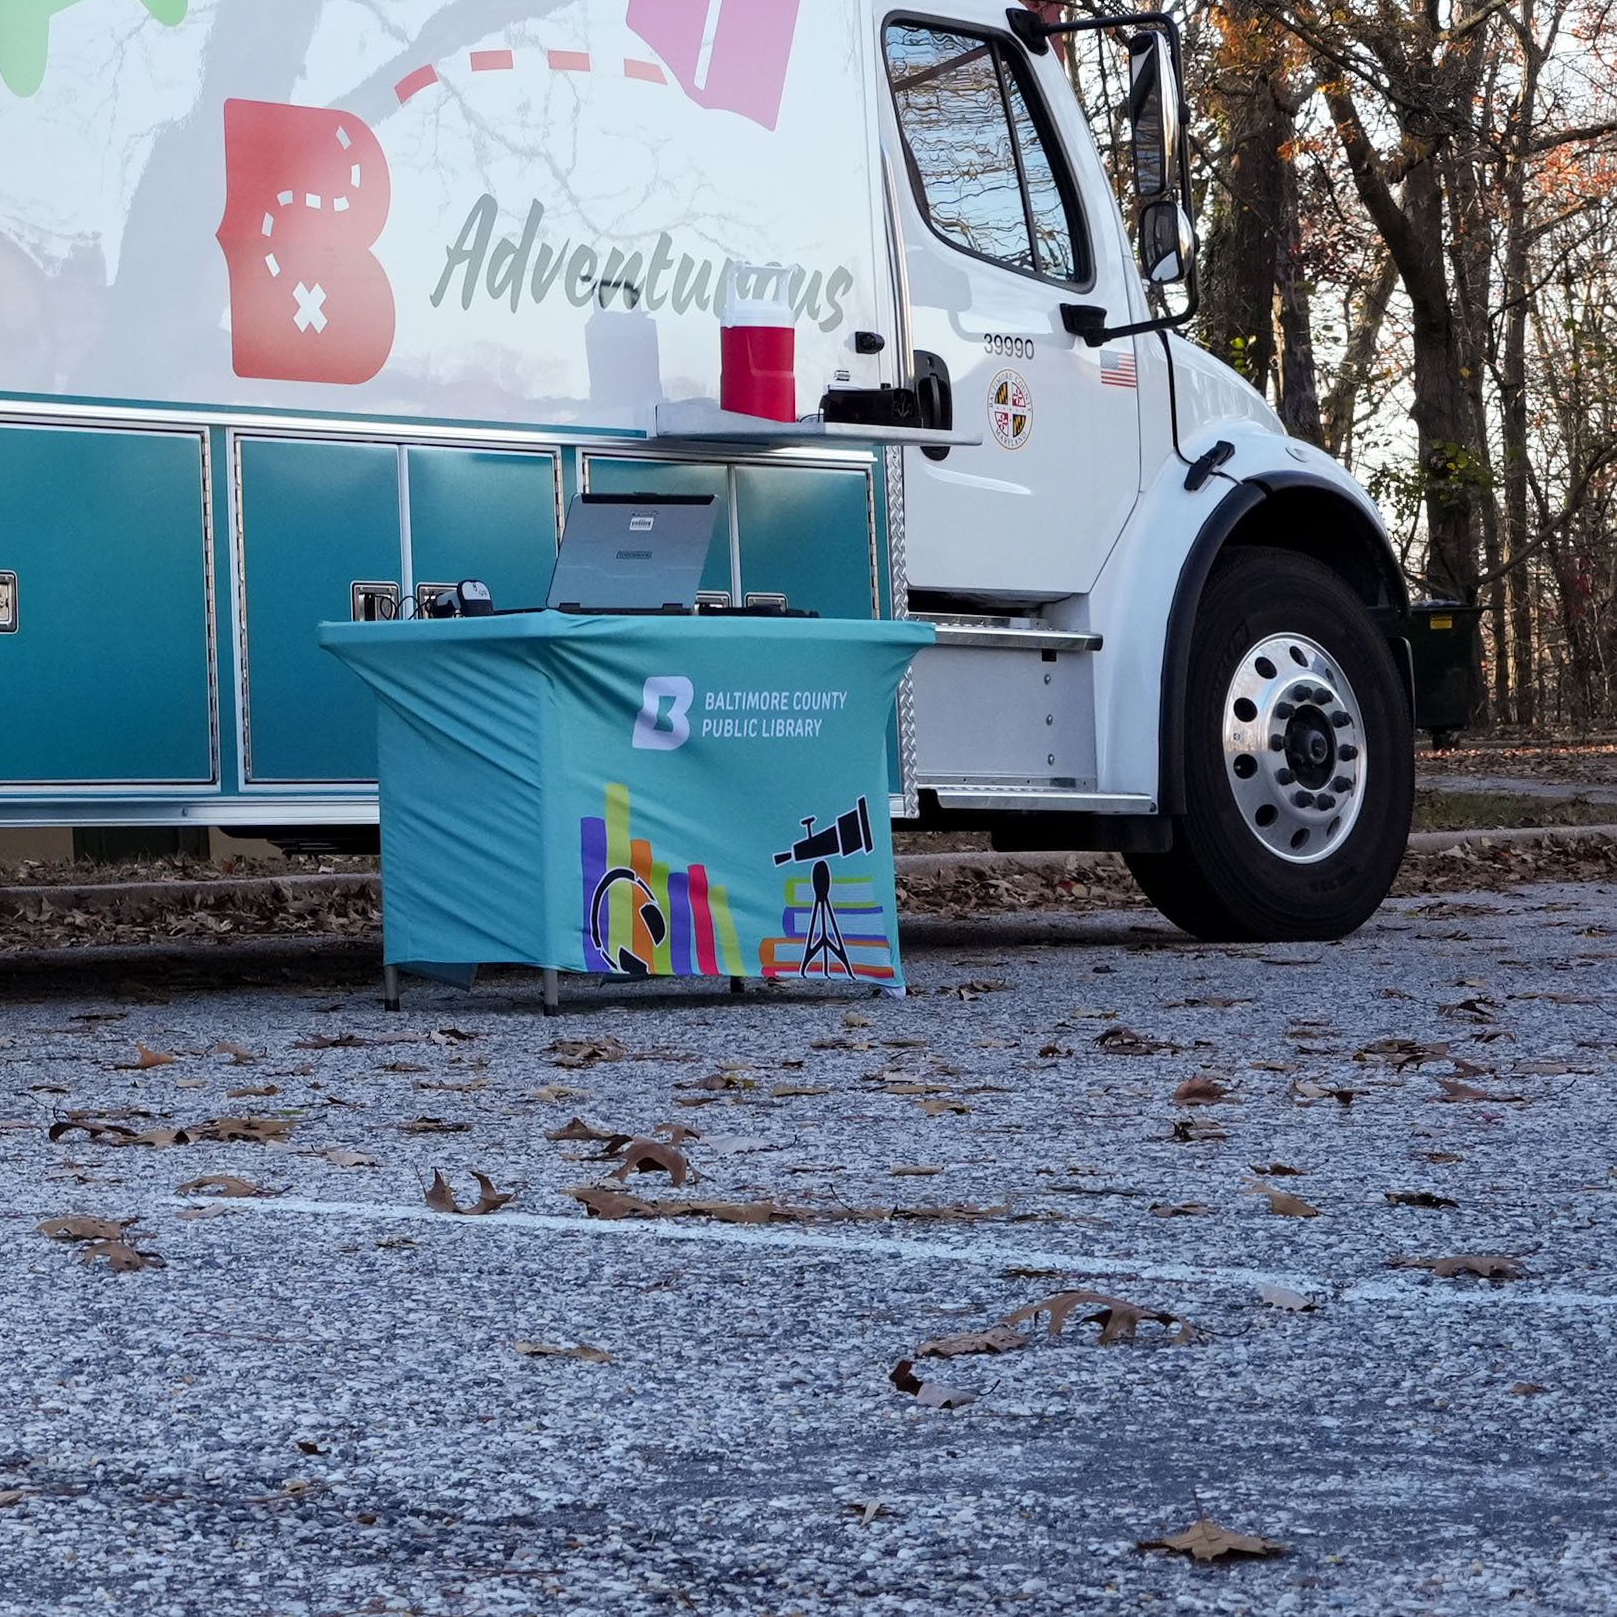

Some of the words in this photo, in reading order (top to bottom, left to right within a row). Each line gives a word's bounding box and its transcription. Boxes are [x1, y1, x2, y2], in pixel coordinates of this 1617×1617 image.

[984, 333, 1035, 360] 39990
[705, 691, 790, 712] BALTIMORE
[792, 690, 848, 711] COUNTY
[701, 717, 759, 738] PUBLIC
[762, 718, 822, 738] LIBRARY
